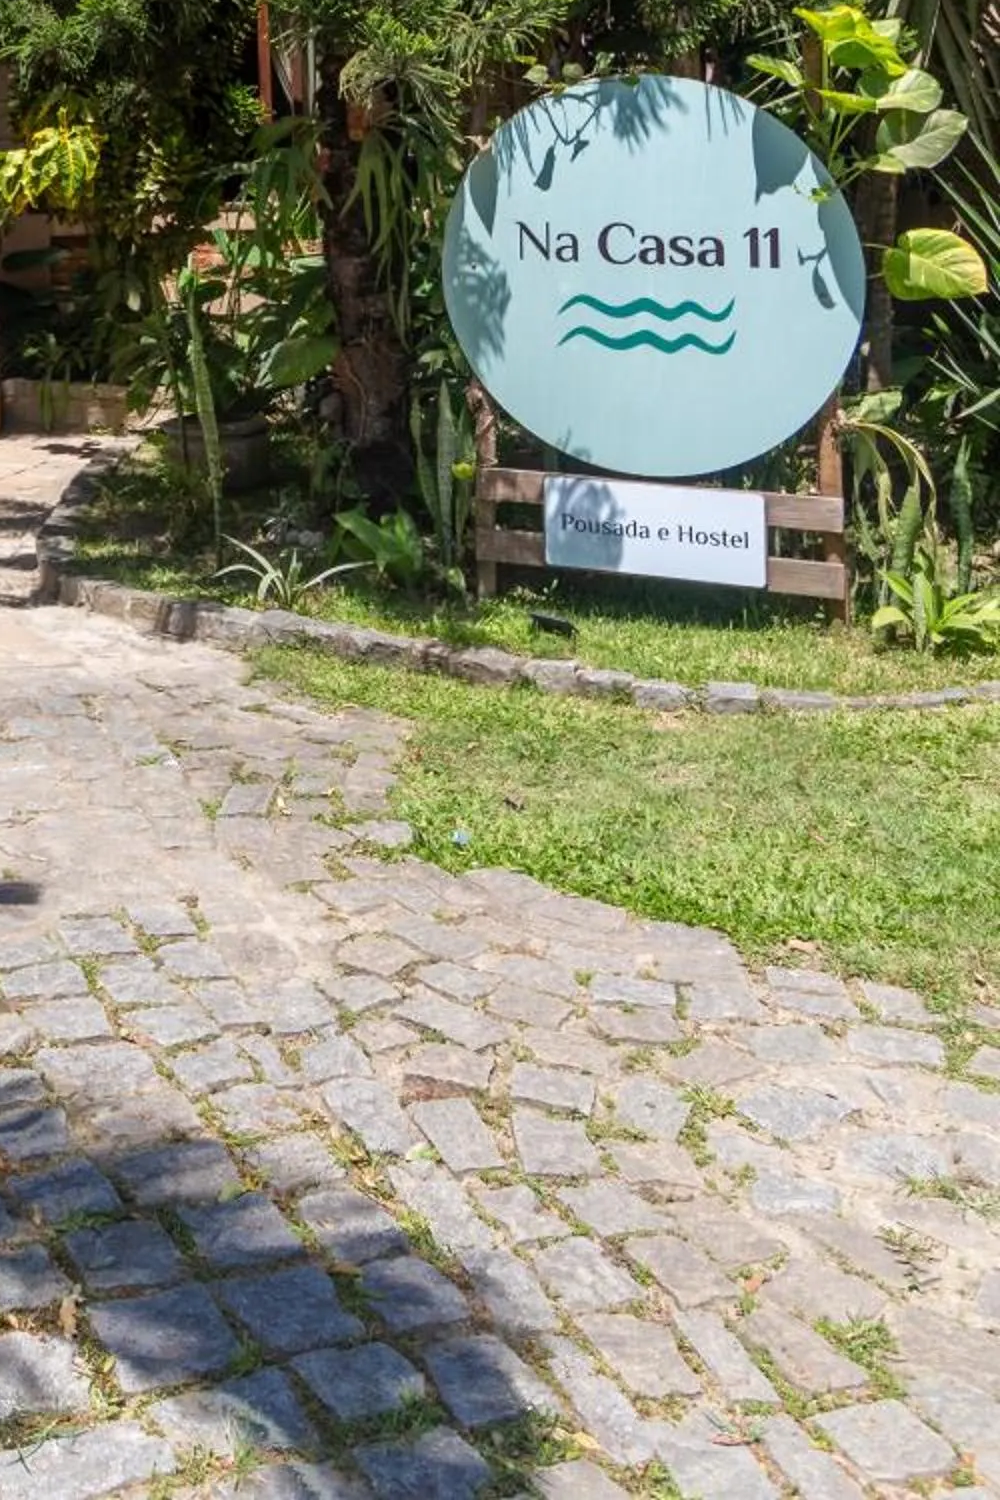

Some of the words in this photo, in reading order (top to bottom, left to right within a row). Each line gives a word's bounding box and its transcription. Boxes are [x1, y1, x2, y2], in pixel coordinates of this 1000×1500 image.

[515, 221, 579, 263] Na
[597, 222, 725, 267] Casa
[743, 227, 781, 269] 11
[561, 513, 651, 539] Pousada
[657, 525, 670, 541] e
[677, 525, 750, 549] Hostel
